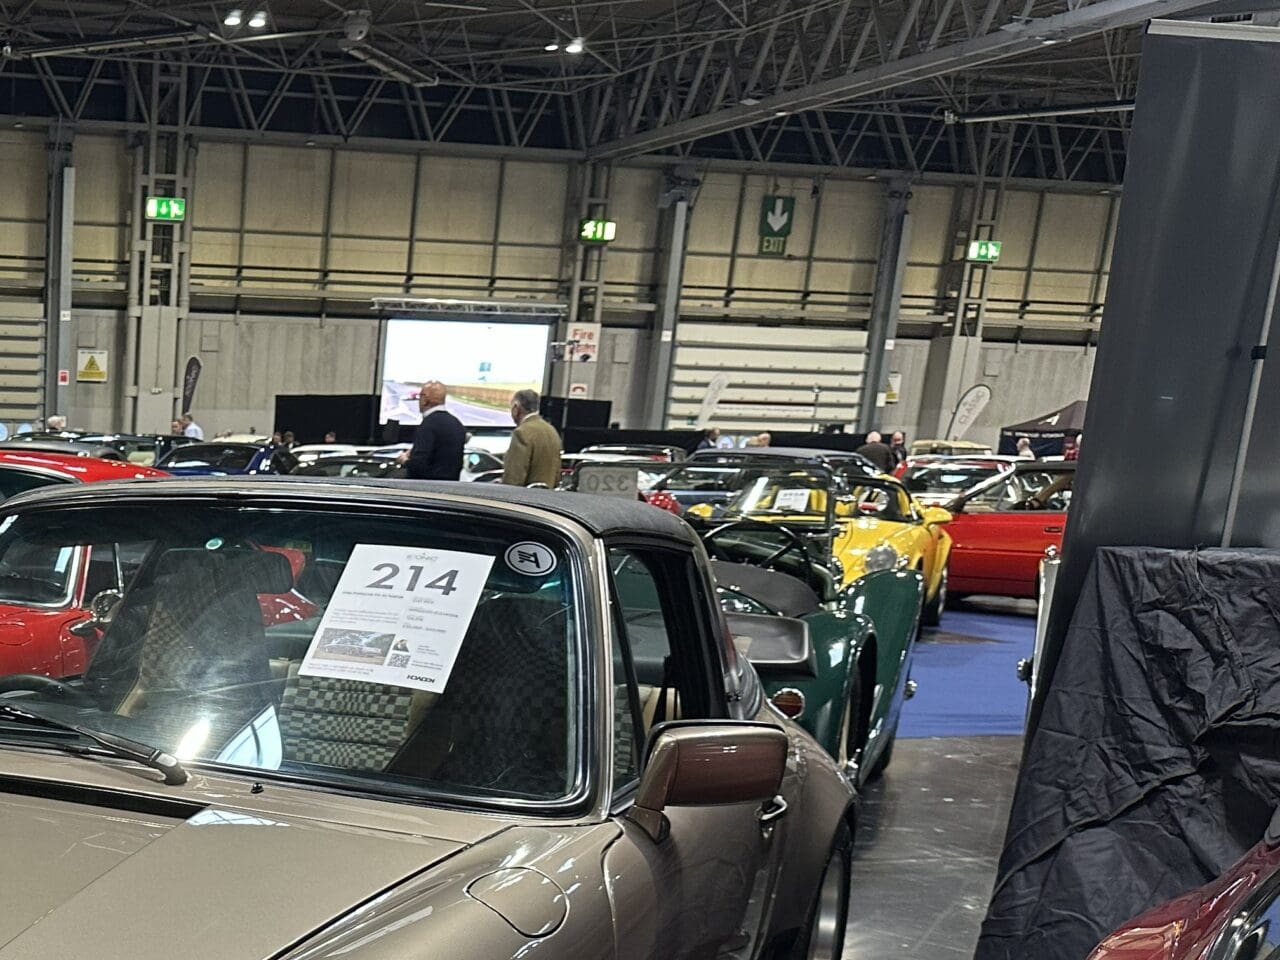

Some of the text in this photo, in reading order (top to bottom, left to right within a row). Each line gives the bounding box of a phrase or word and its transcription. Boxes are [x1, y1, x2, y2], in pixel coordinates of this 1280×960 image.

[763, 236, 785, 253] EXIT
[572, 328, 595, 340] Fire
[365, 562, 459, 596] 214
